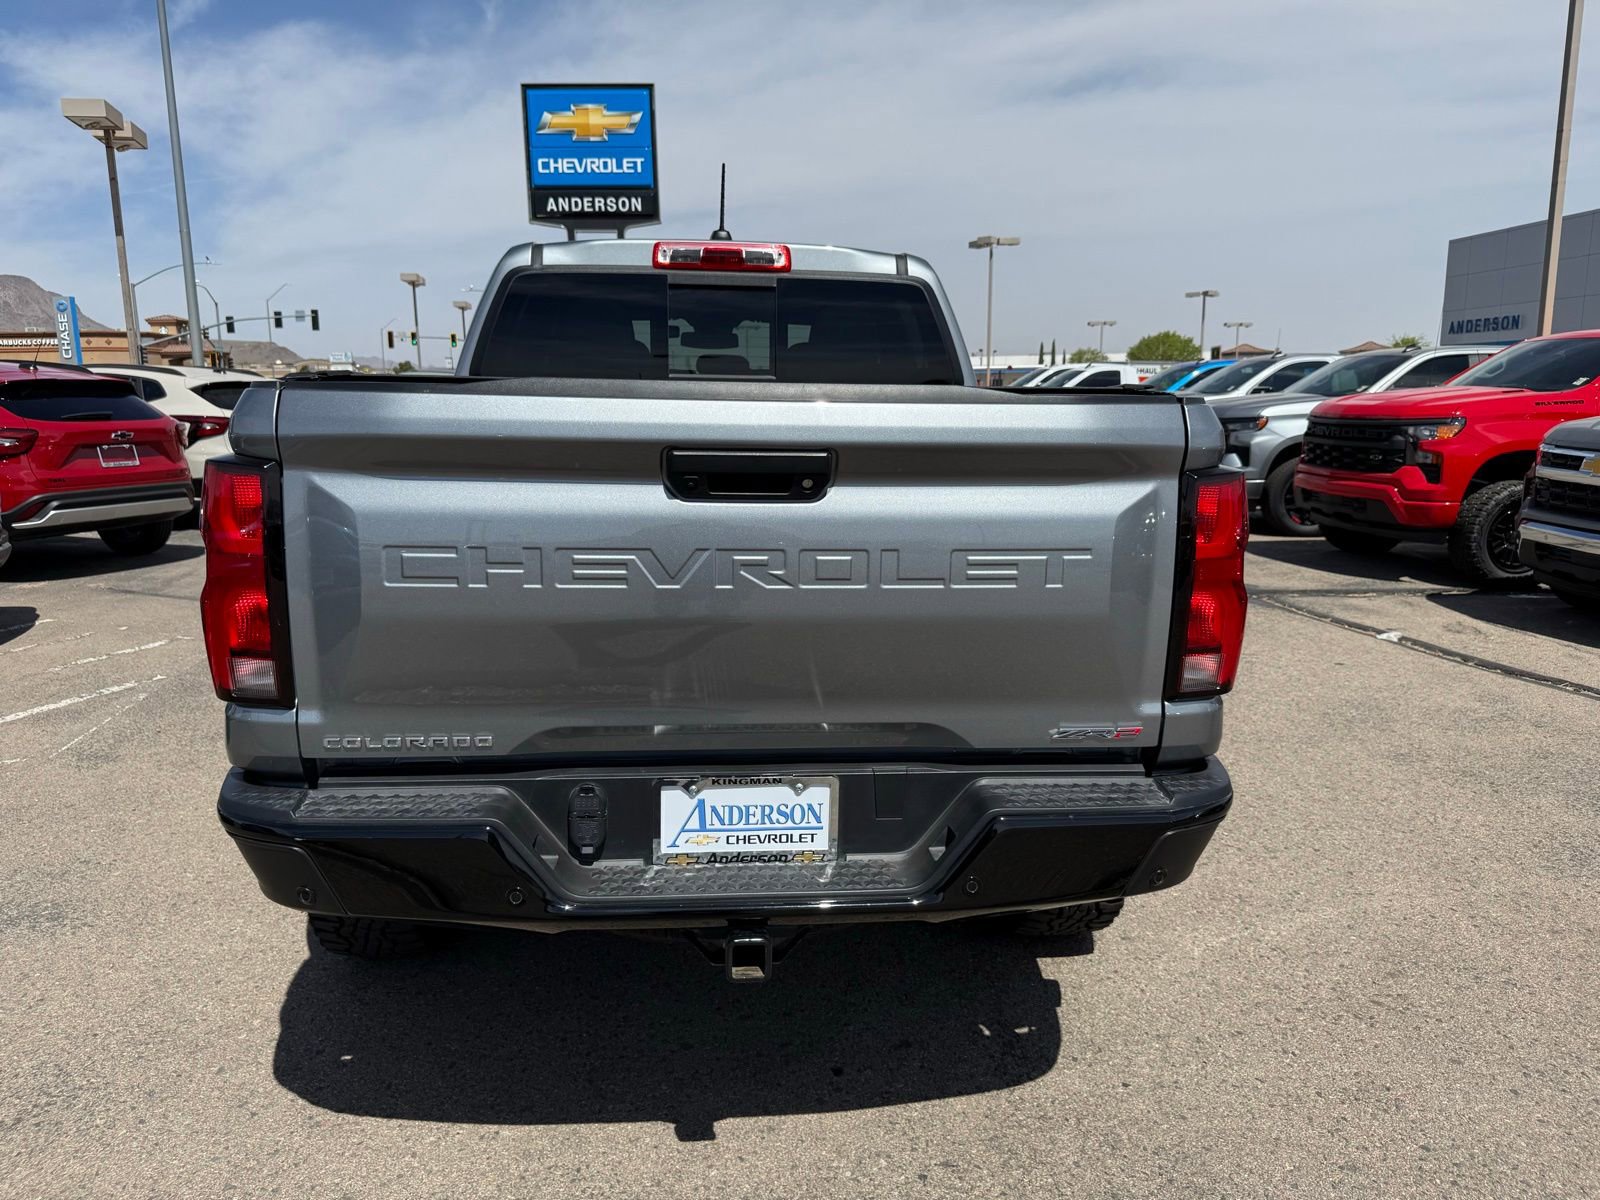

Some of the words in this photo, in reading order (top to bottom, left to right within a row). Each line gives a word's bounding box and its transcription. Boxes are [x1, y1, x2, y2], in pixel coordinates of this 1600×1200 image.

[538, 158, 645, 173] CHEVROLET
[547, 197, 642, 212] ANDERSON
[1448, 315, 1520, 335] ANDERSON
[58, 313, 72, 359] CHASE
[383, 545, 1092, 588] CHEVROLET
[323, 735, 493, 748] COLORADO
[711, 777, 783, 786] KINGMAN
[726, 833, 818, 845] CHEVROLET
[706, 852, 789, 865] Anderson
